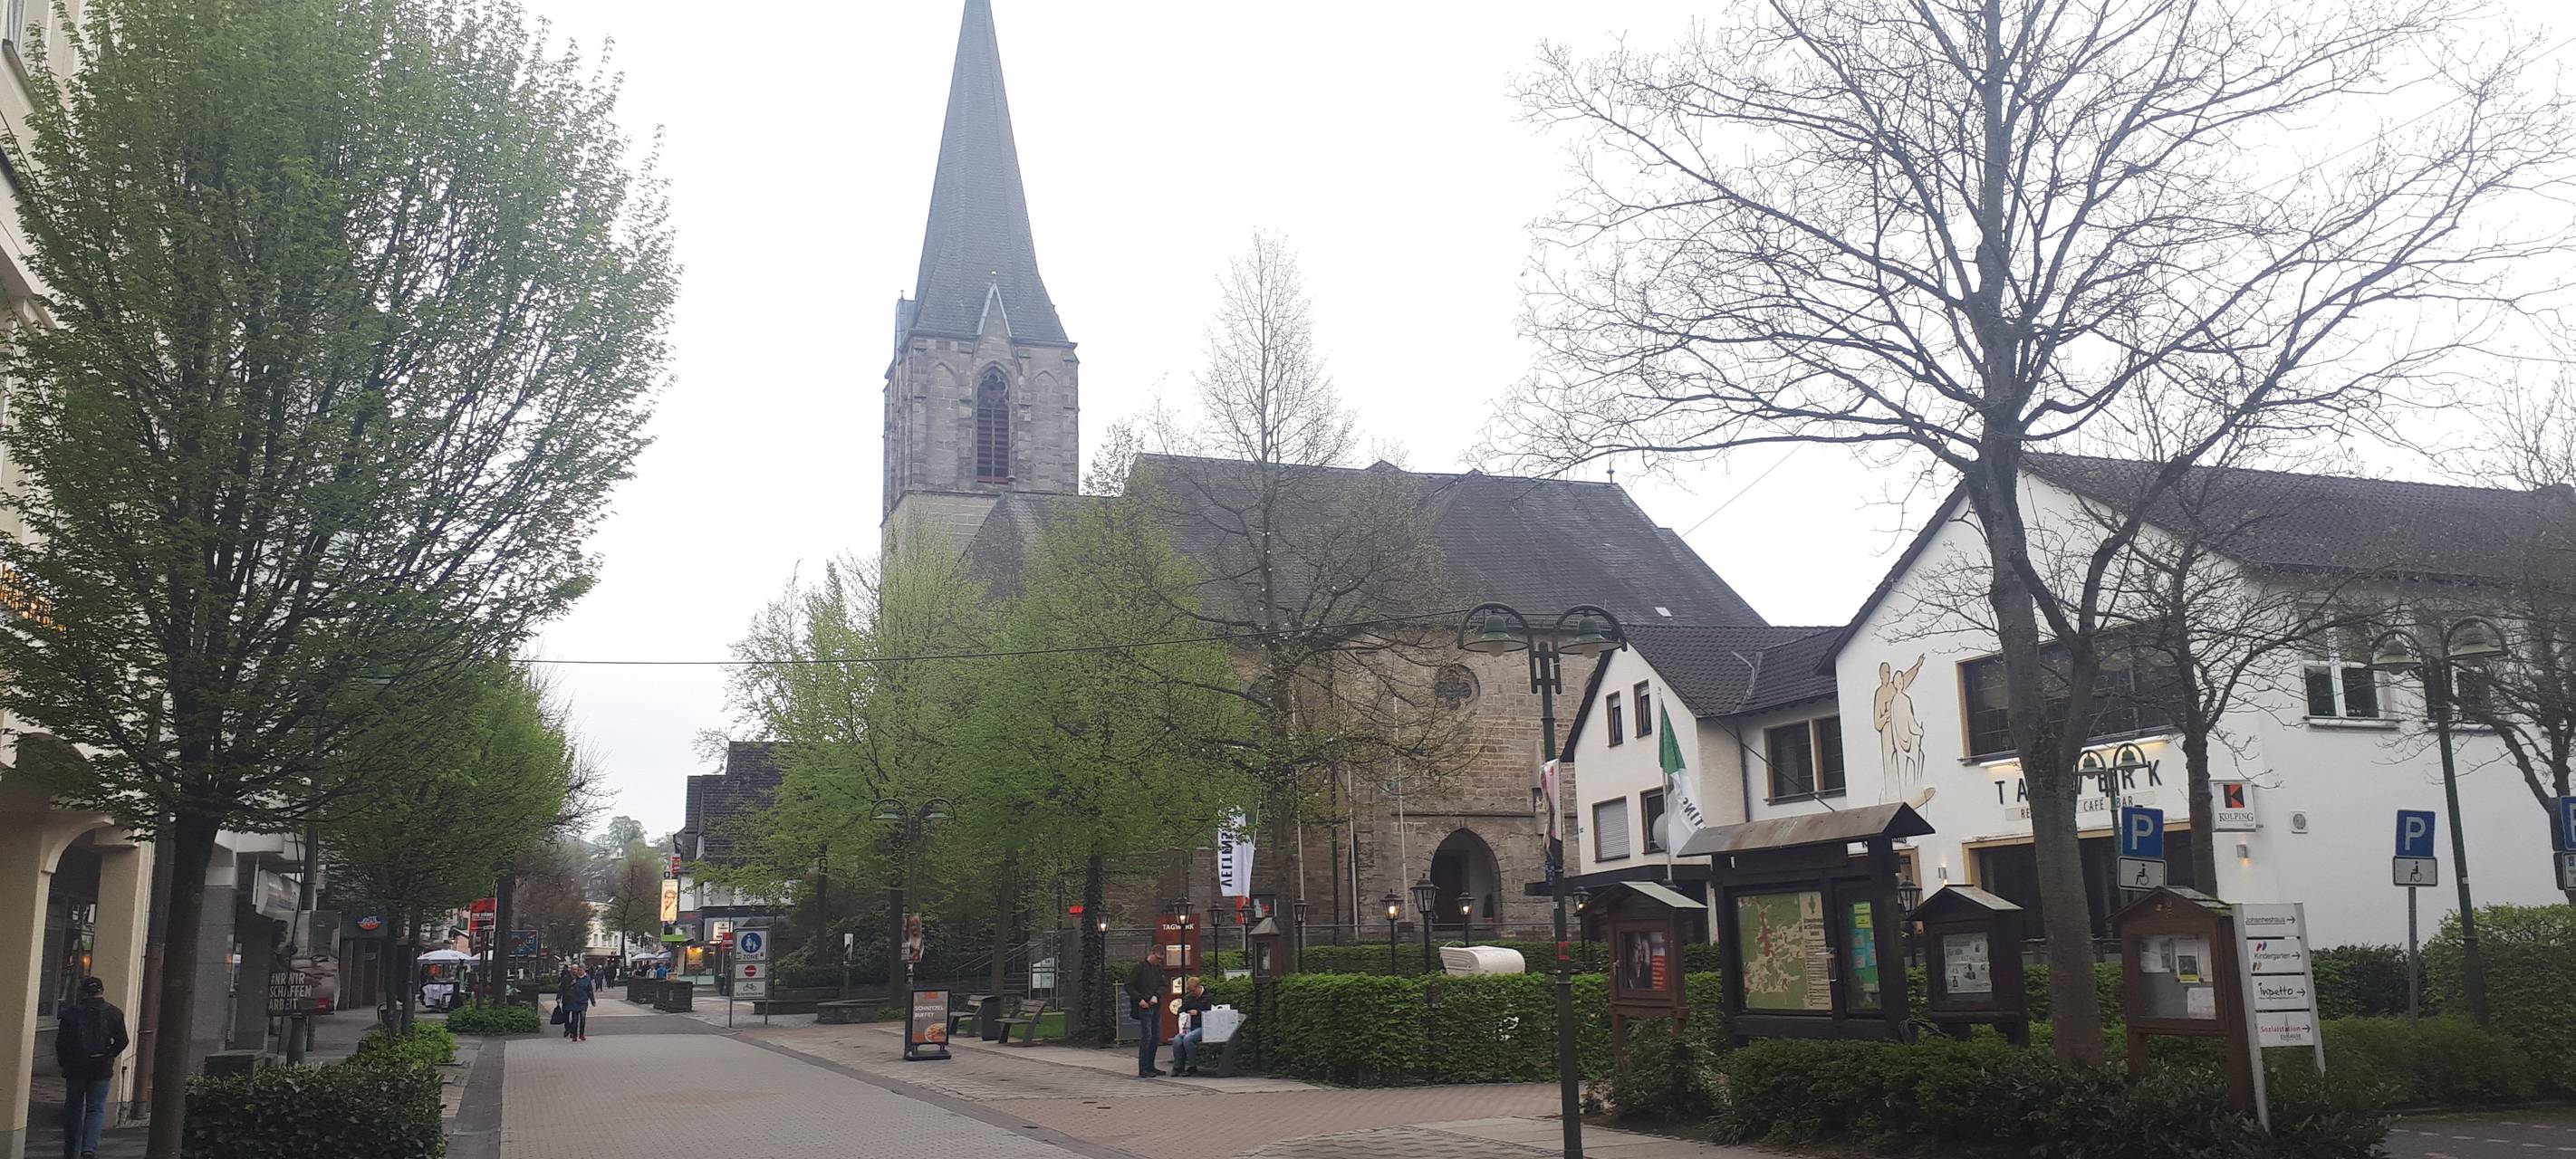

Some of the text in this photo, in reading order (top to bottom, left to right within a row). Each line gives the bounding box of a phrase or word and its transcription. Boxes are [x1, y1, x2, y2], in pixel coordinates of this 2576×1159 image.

[2116, 796, 2133, 809] BAR
[2219, 812, 2254, 822] KOLPING
[2131, 814, 2154, 850] P
[2405, 817, 2426, 851] P
[2254, 953, 2291, 962] Kindergarten
[268, 998, 299, 1011] ARBEIT
